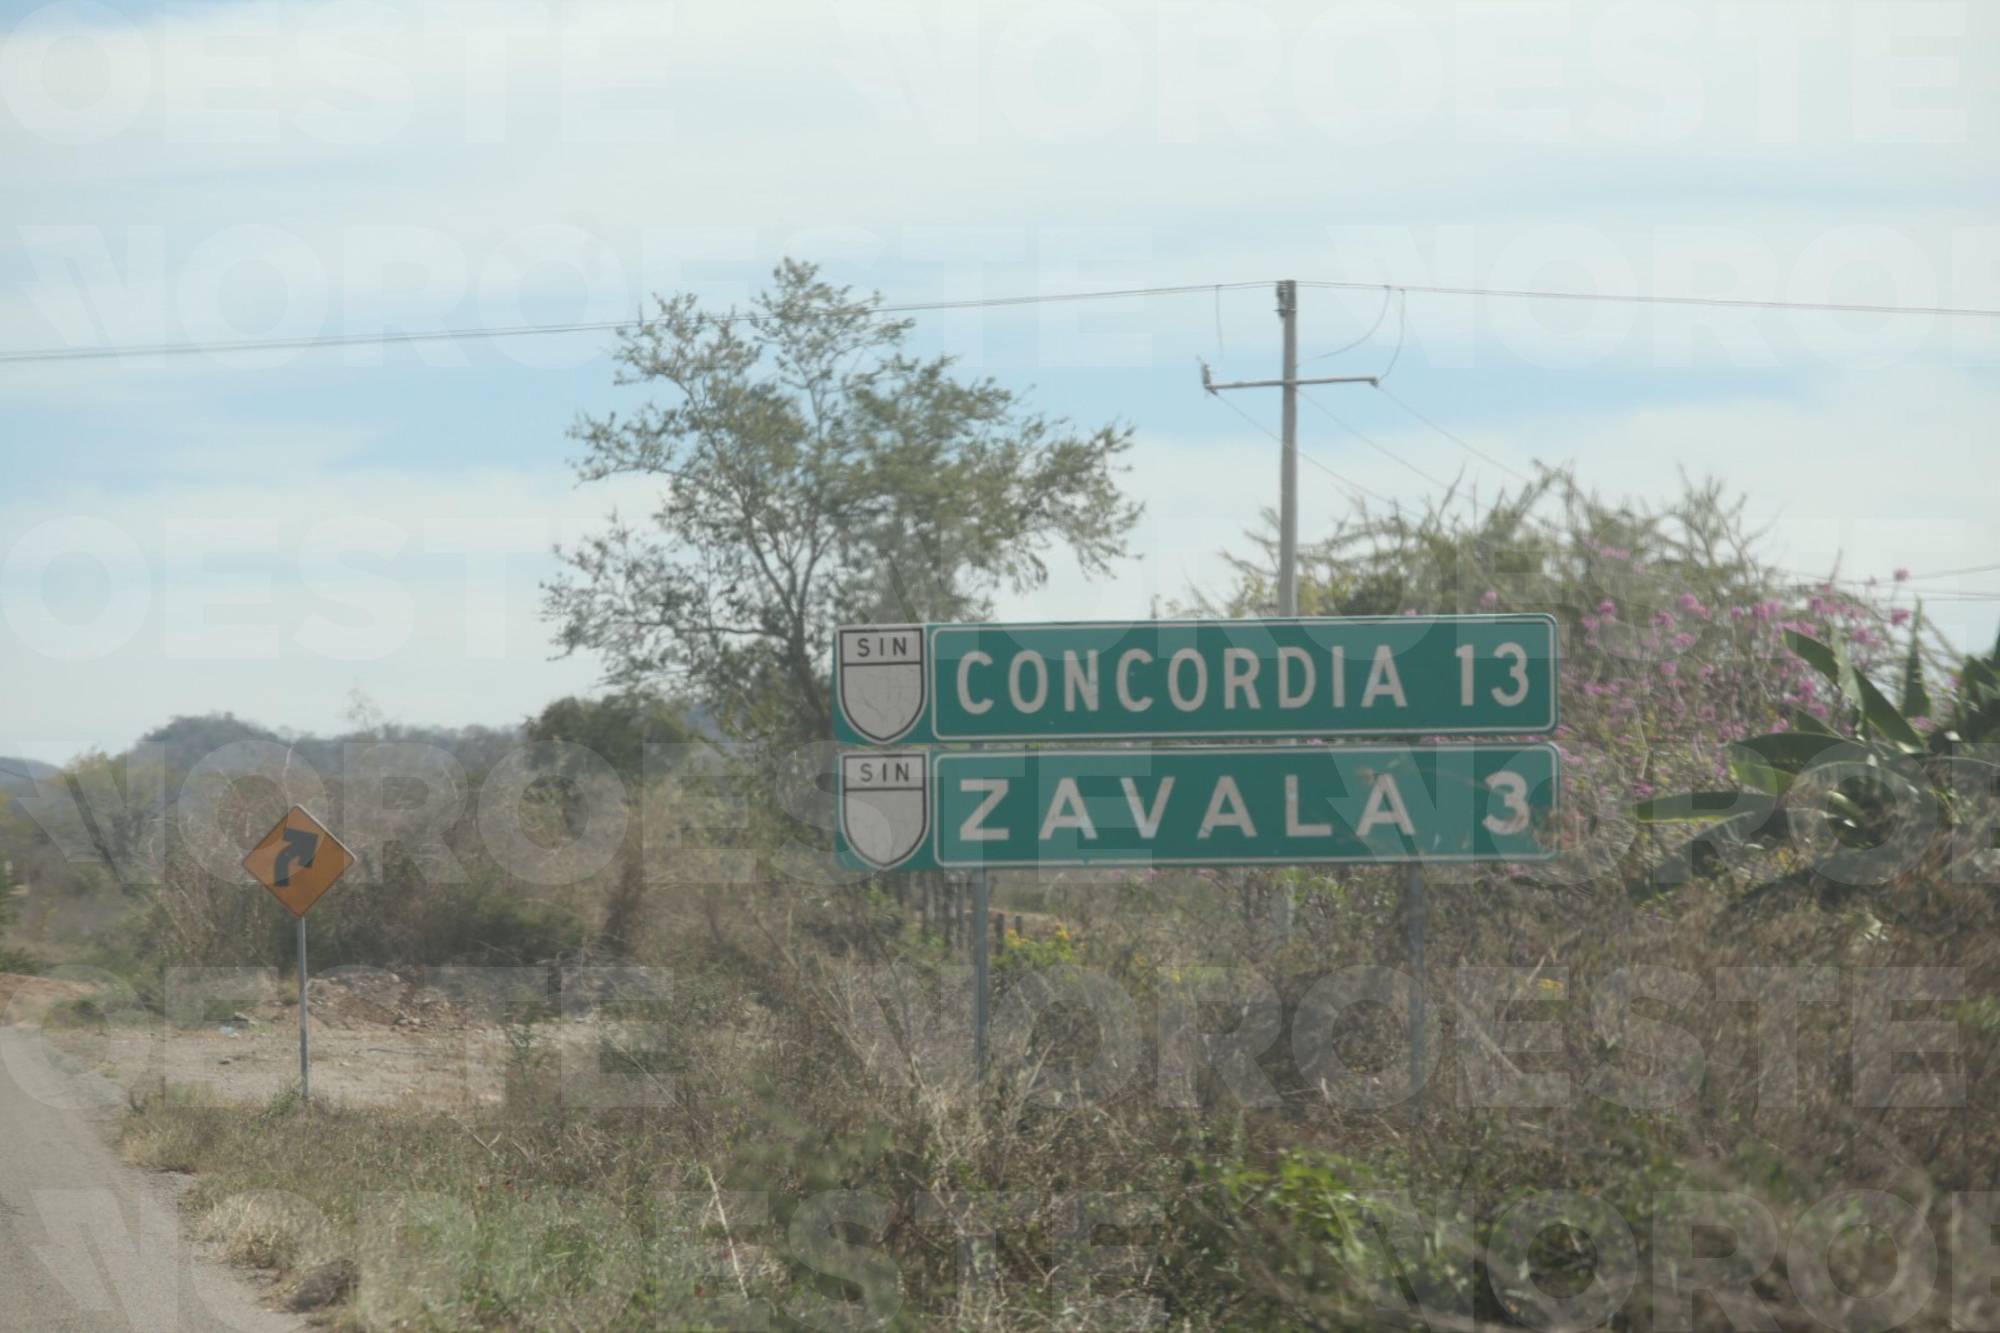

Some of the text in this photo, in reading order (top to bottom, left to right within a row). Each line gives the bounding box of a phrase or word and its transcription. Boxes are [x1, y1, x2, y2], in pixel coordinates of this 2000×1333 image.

[857, 637, 907, 657] SIN
[956, 642, 1529, 714] CONCORDIA 13
[860, 763, 909, 783] SIN
[959, 770, 1530, 841] ZAVALA 3
